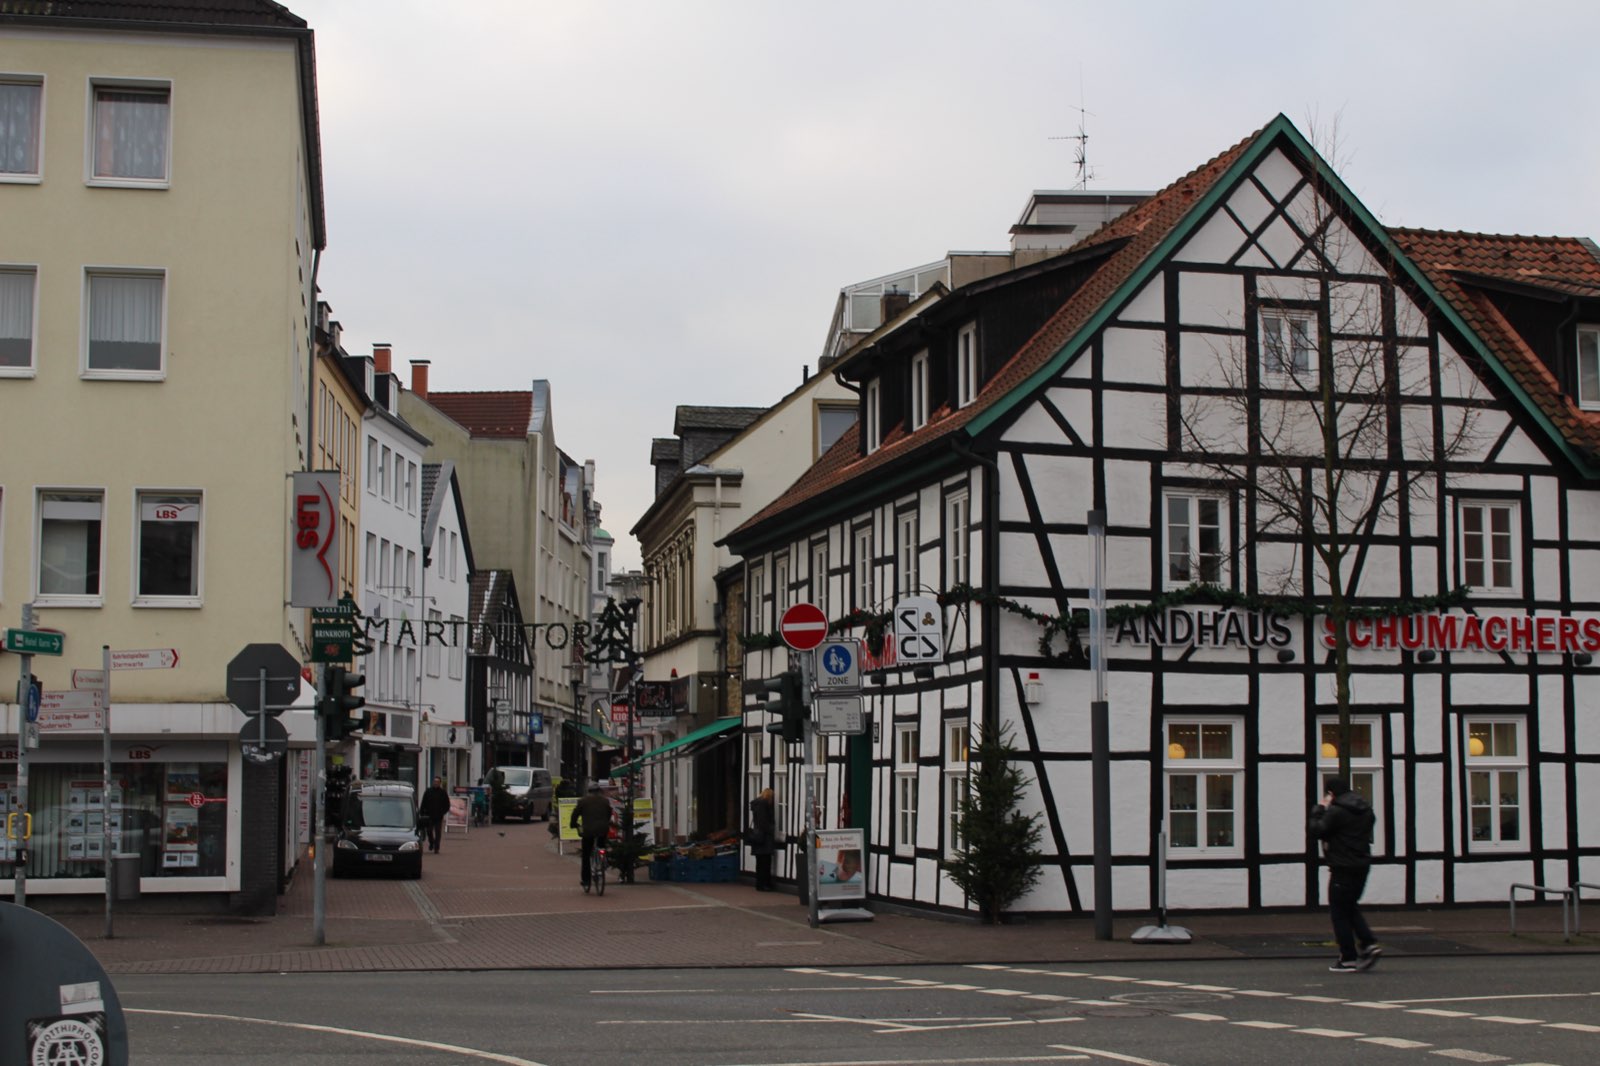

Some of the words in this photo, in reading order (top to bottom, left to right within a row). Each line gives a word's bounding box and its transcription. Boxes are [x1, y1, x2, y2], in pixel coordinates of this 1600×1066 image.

[156, 510, 177, 520] LBS
[297, 495, 320, 549] LBS
[827, 677, 849, 685] ZONE
[129, 750, 151, 759] LBS
